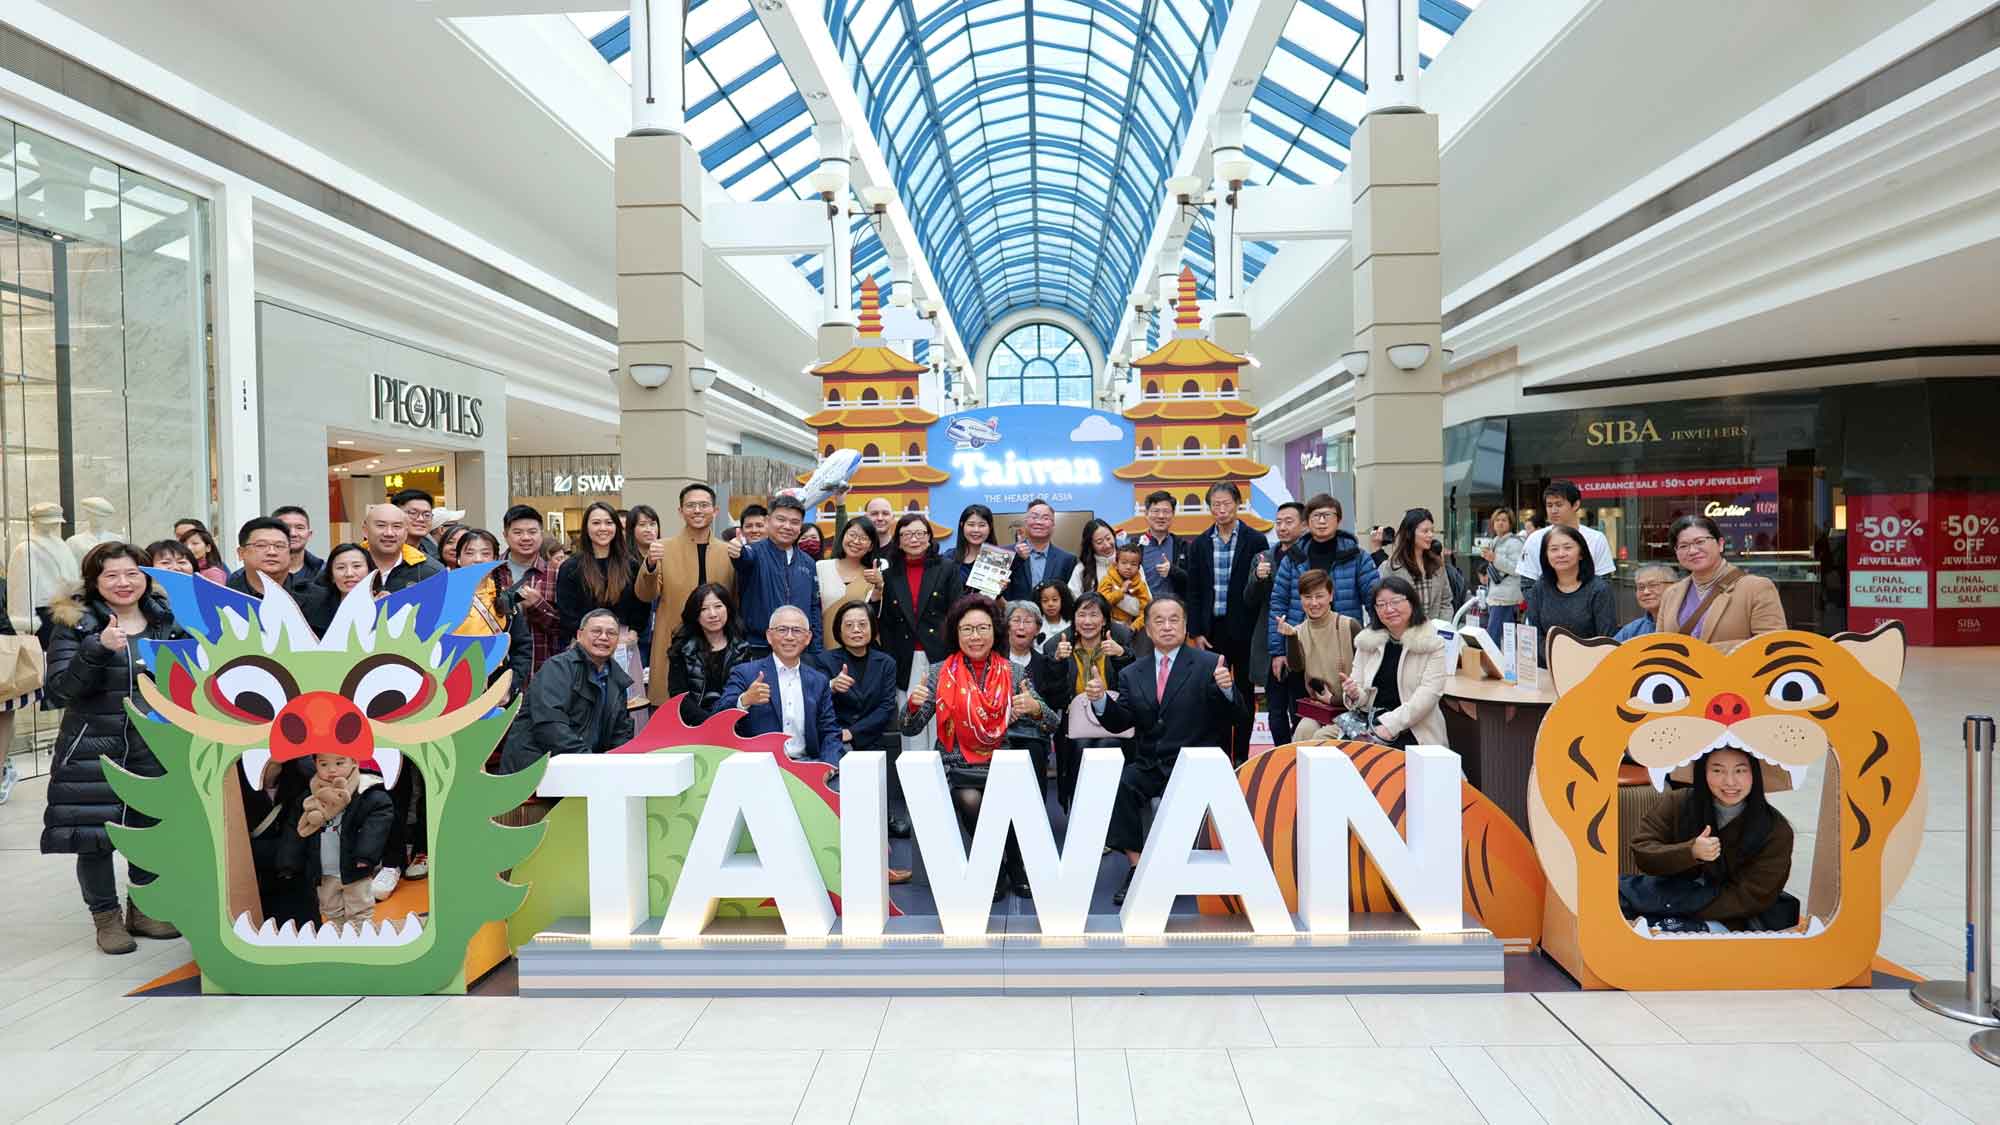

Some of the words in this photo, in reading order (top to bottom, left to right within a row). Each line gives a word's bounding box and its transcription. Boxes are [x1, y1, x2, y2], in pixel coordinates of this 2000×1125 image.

[373, 373, 484, 438] PEOPLES
[1586, 417, 1662, 447] SIBA
[1670, 425, 1749, 441] JEWELLERS
[952, 451, 1102, 487] Taiwan
[1584, 480, 1635, 491] CLEARANCE
[1636, 479, 1658, 489] SALE
[1687, 477, 1704, 488] OFF
[1705, 475, 1762, 487] JEWELLERY
[984, 494, 1001, 503] THE
[1003, 494, 1034, 502] HEART
[1051, 492, 1073, 501] ASIA
[1704, 501, 1751, 517] Cartier
[1863, 515, 1924, 538] 50%
[1947, 514, 2000, 537] 50%
[1870, 539, 1908, 553] OFF
[1953, 538, 1985, 552] OFF
[1857, 556, 1923, 566] JEWELLERY
[1942, 555, 1998, 565] JEWELLERY
[1872, 575, 1905, 585] FINAL
[1956, 575, 1985, 584] FINAL
[1855, 585, 1923, 594] CLEARANCE
[1940, 584, 2000, 594] CLEARANCE
[1874, 595, 1903, 603] SALE
[1957, 594, 1984, 603] SALE
[1957, 618, 1981, 628] SIBA
[537, 744, 1463, 940] TAIWAN
